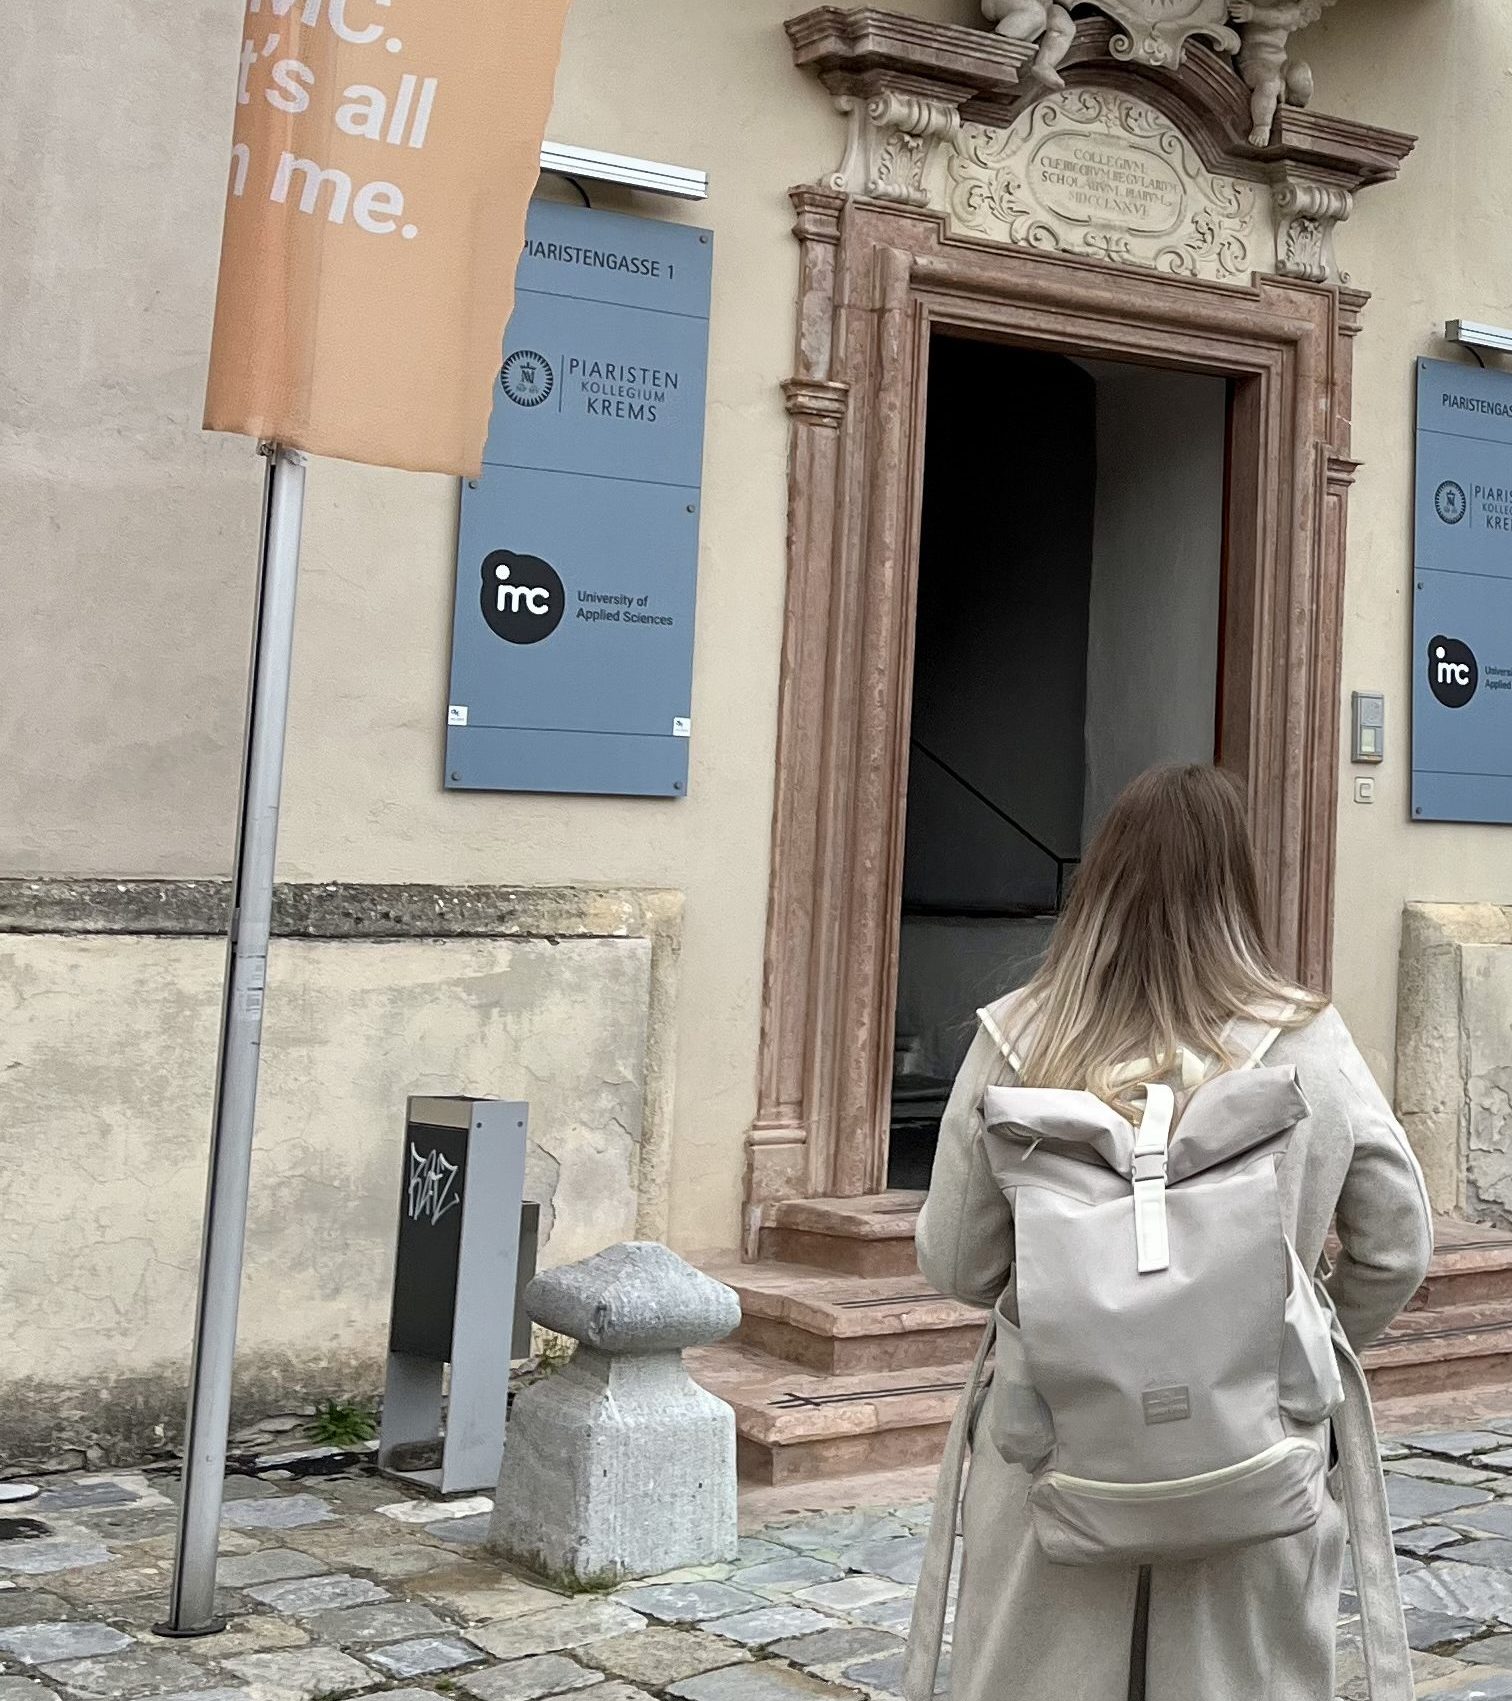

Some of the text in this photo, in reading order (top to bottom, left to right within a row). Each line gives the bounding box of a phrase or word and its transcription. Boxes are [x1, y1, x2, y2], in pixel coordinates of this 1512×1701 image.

[335, 74, 438, 149] all
[269, 150, 418, 240] me.
[667, 264, 675, 280] 1
[569, 358, 679, 390] PIARISTEN
[581, 381, 666, 403] KOLLEGIUM
[586, 397, 658, 422] KREMS
[495, 564, 550, 615] imc
[577, 590, 649, 608] University of
[576, 608, 674, 626] Applied Sciences
[1435, 646, 1470, 686] imc
[1485, 679, 1512, 691] Applied
